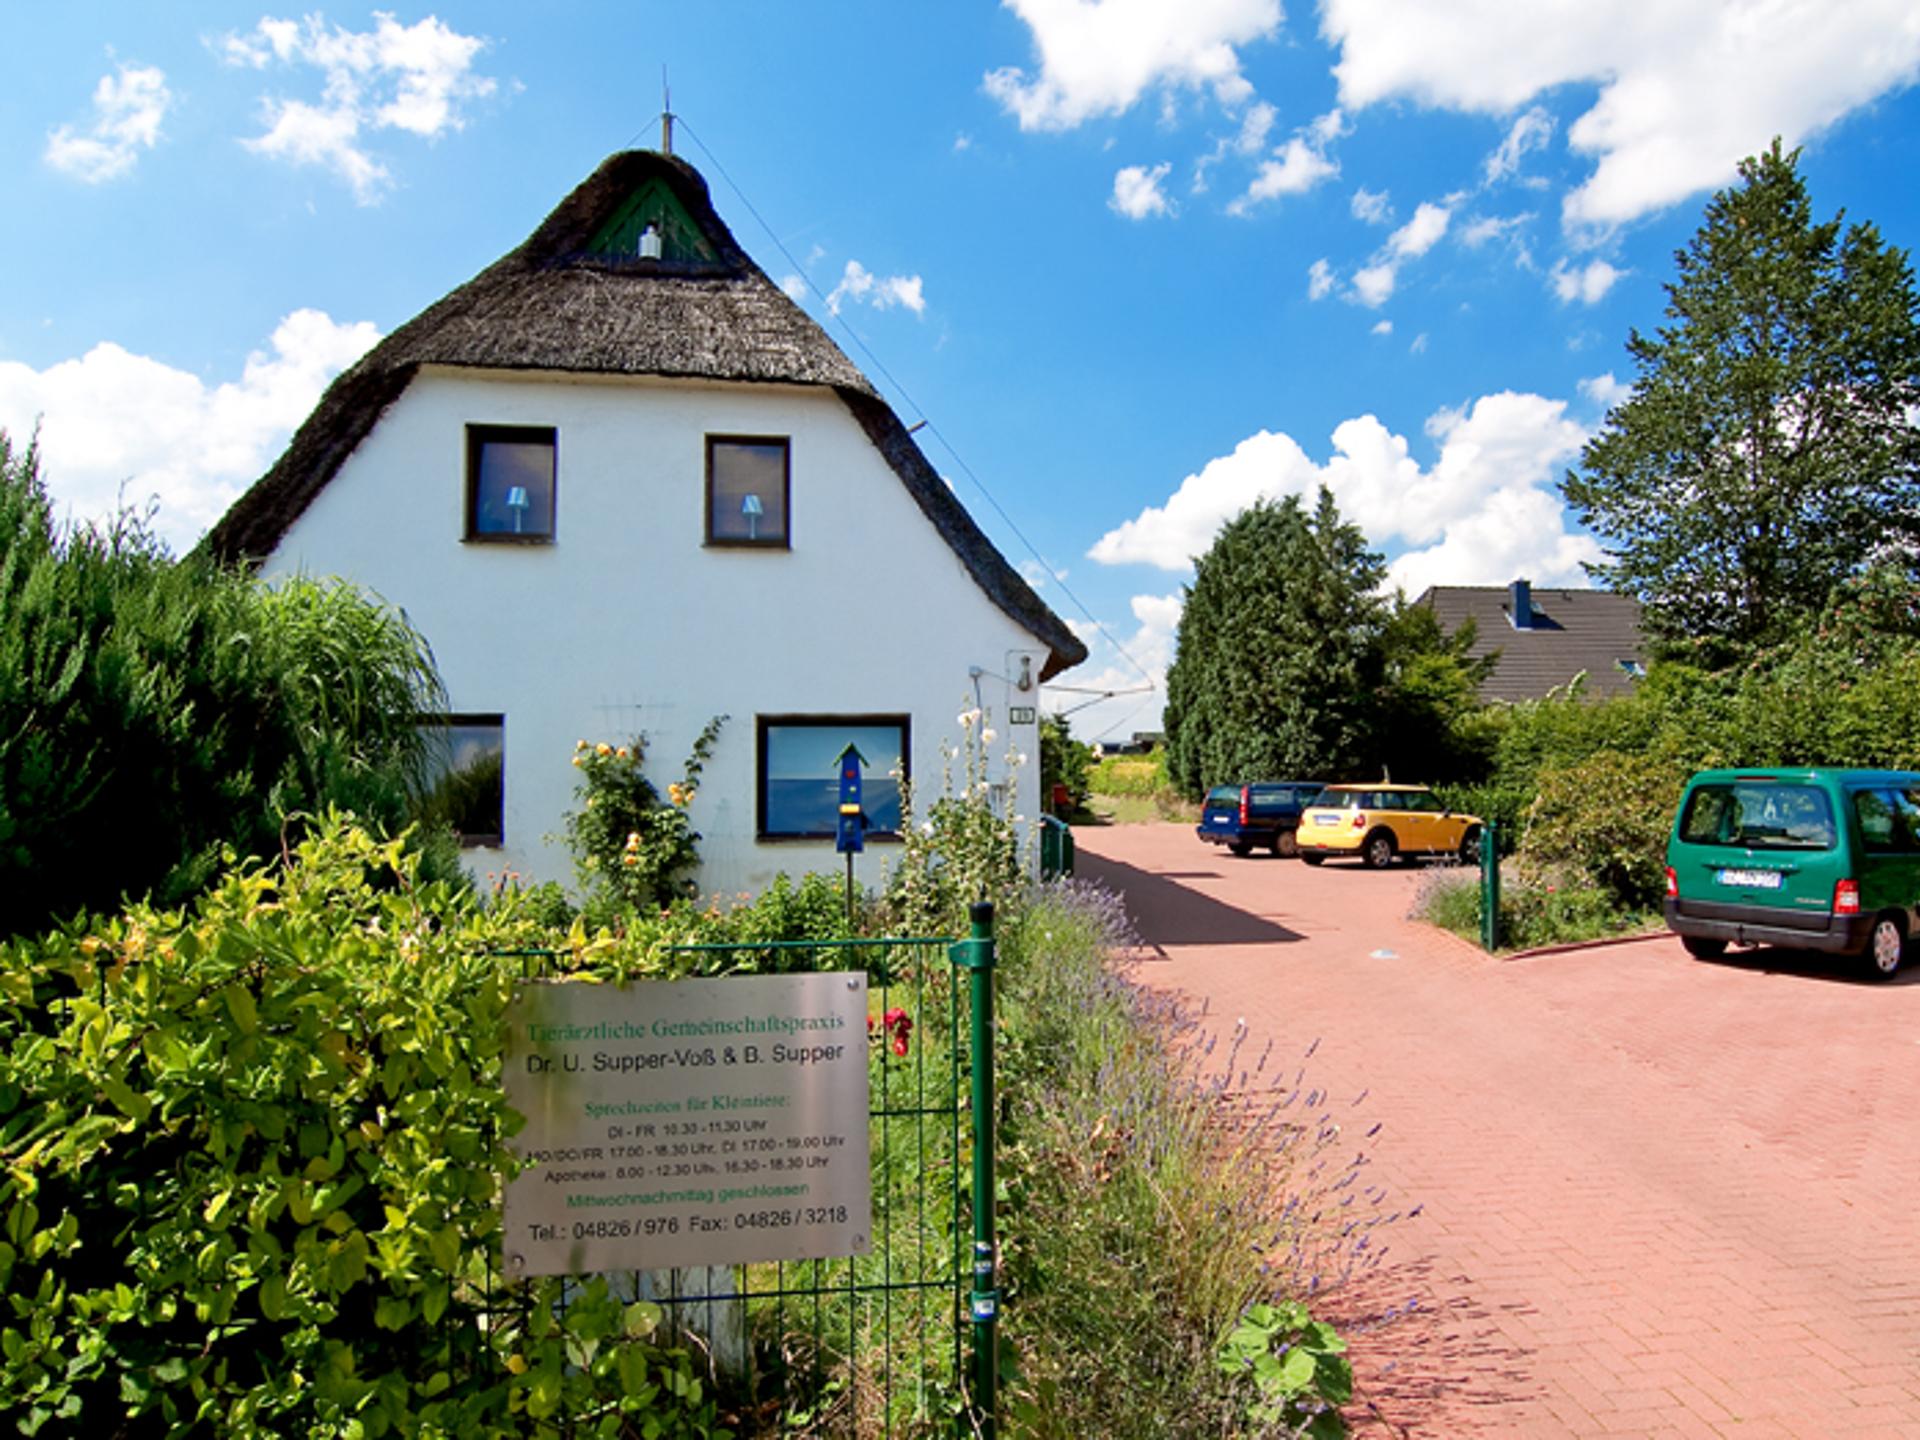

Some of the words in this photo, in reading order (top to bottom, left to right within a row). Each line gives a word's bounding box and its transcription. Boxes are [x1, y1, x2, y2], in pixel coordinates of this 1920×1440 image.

[526, 1019, 646, 1042] Tierärztliche
[651, 1011, 844, 1038] Gemeinschaftspraxis
[527, 1053, 557, 1073] Dr.
[563, 1053, 585, 1072] U.
[593, 1048, 716, 1074] Supper-Voß
[723, 1046, 737, 1064] &
[745, 1045, 764, 1063] B.
[772, 1043, 844, 1067] Supper
[687, 1096, 707, 1111] für
[635, 1124, 656, 1137] FR
[743, 1119, 767, 1132] Uhr
[822, 1135, 845, 1147] Uhr
[806, 1155, 829, 1168] Uhr
[566, 1187, 714, 1208] Mittwochnachmittag
[718, 1183, 809, 1203] geschlossen
[528, 1224, 566, 1241] Tel.:
[689, 1216, 727, 1232] Fax:
